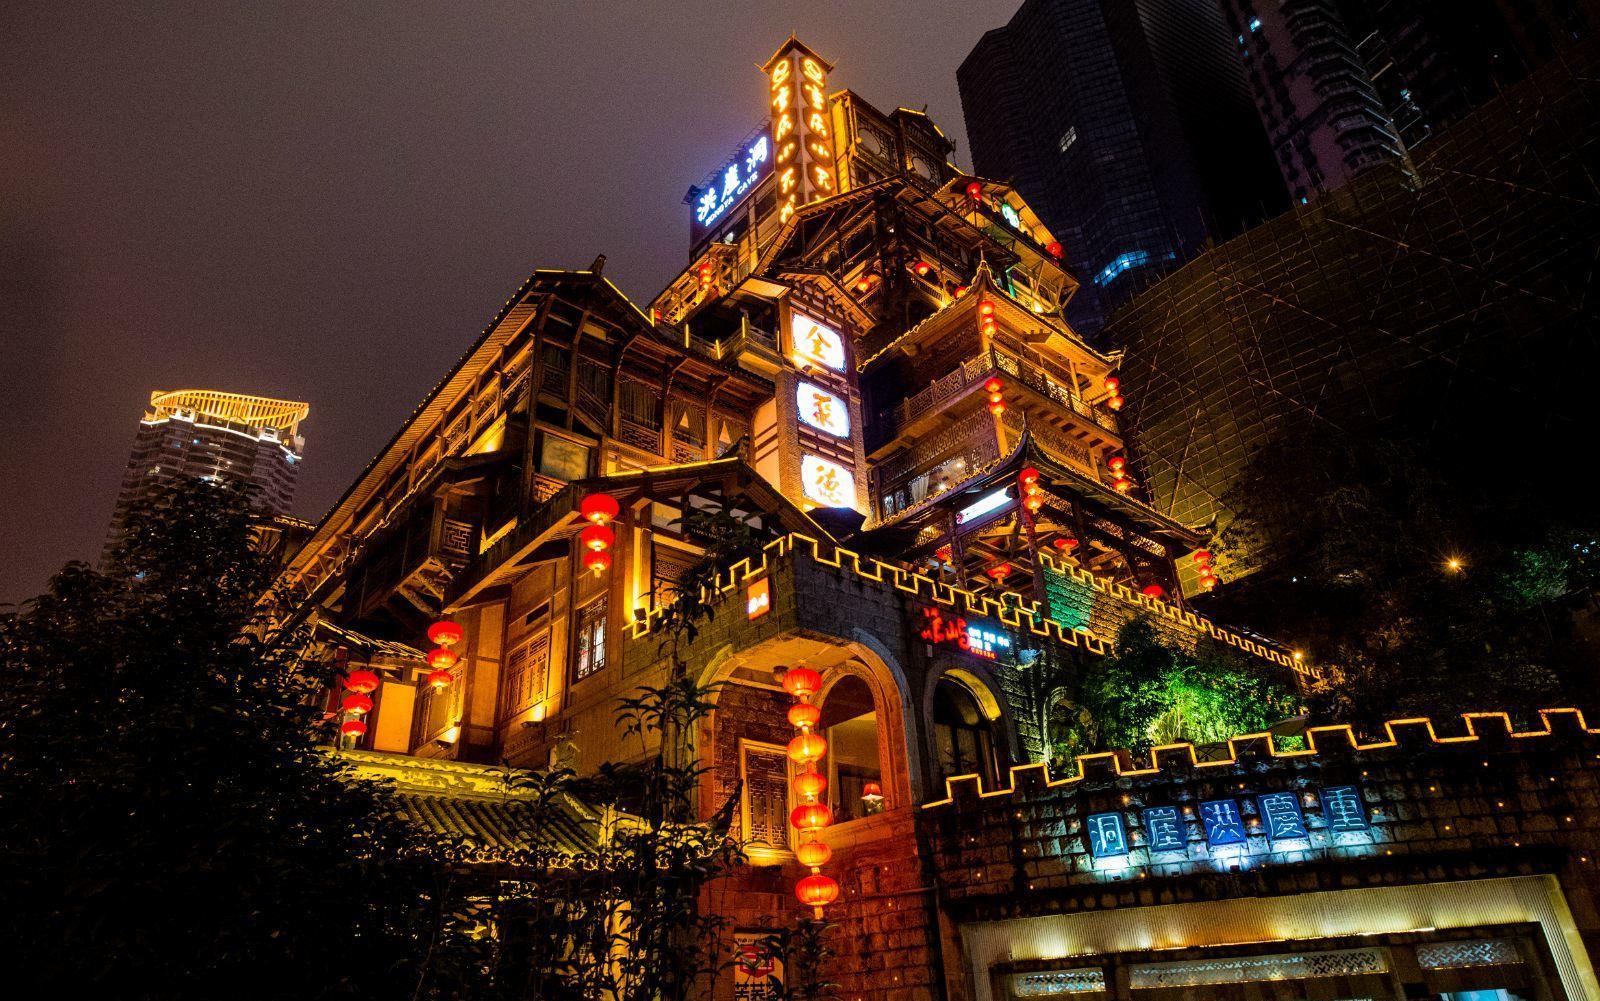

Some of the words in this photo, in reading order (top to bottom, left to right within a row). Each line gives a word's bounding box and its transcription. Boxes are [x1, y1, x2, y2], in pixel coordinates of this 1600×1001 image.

[697, 136, 767, 221] 洪崖洞
[737, 171, 758, 194] CAVE
